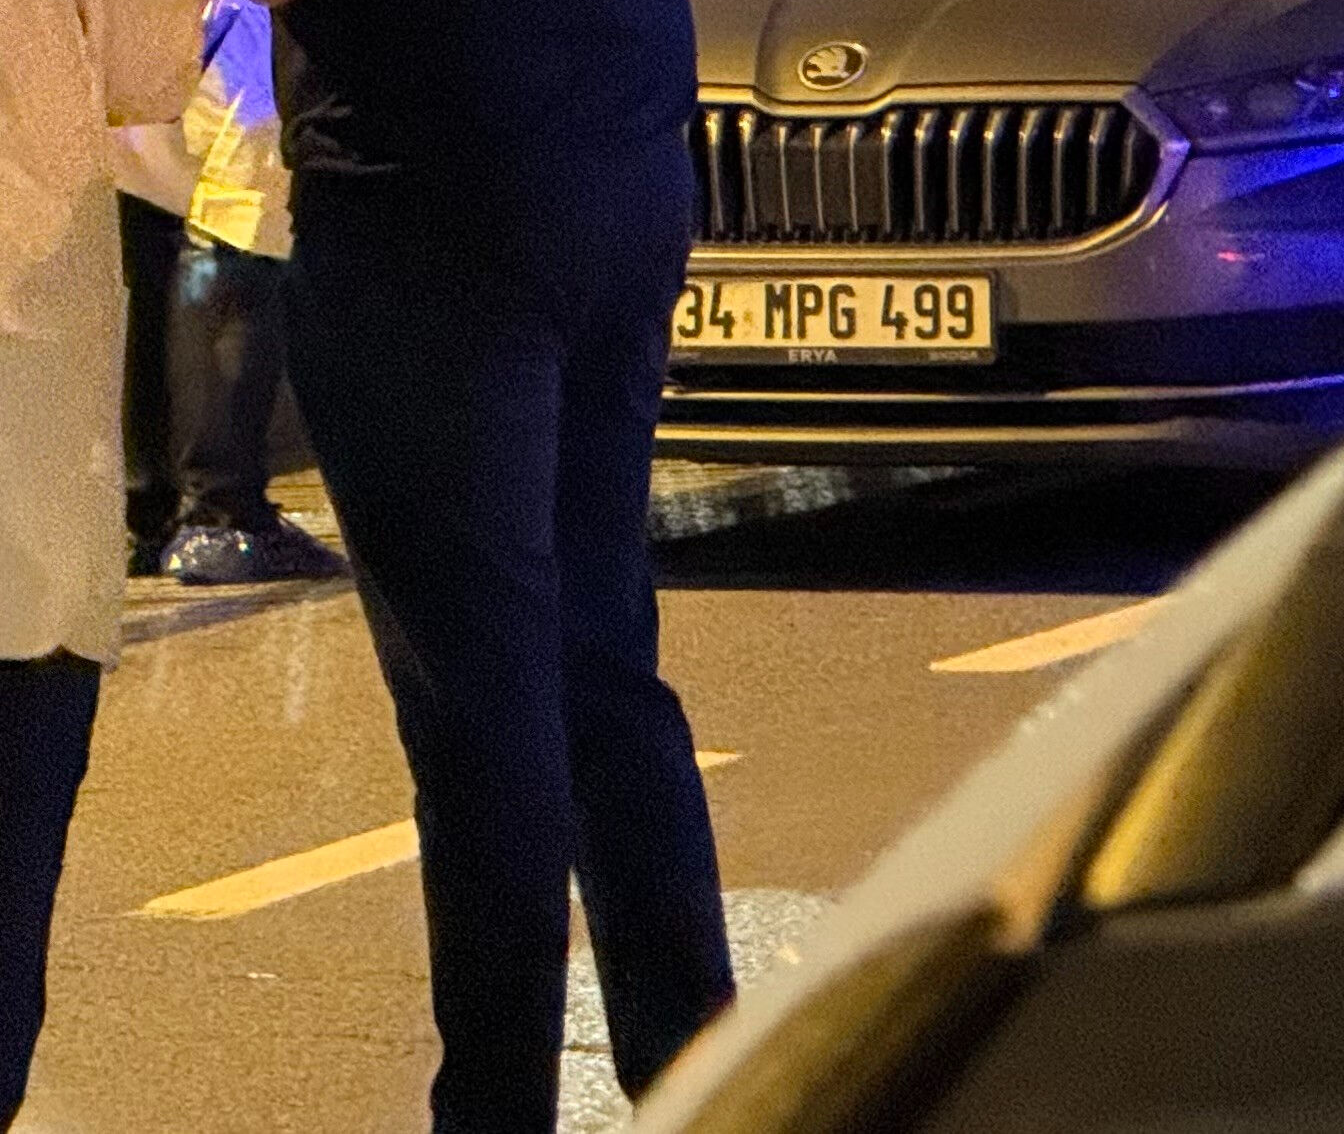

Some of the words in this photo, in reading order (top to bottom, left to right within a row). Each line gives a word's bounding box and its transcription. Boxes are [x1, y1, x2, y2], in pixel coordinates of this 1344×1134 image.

[676, 282, 736, 340] 34
[764, 283, 856, 340] MPG
[880, 283, 975, 340] 499
[787, 349, 838, 364] ERYA
